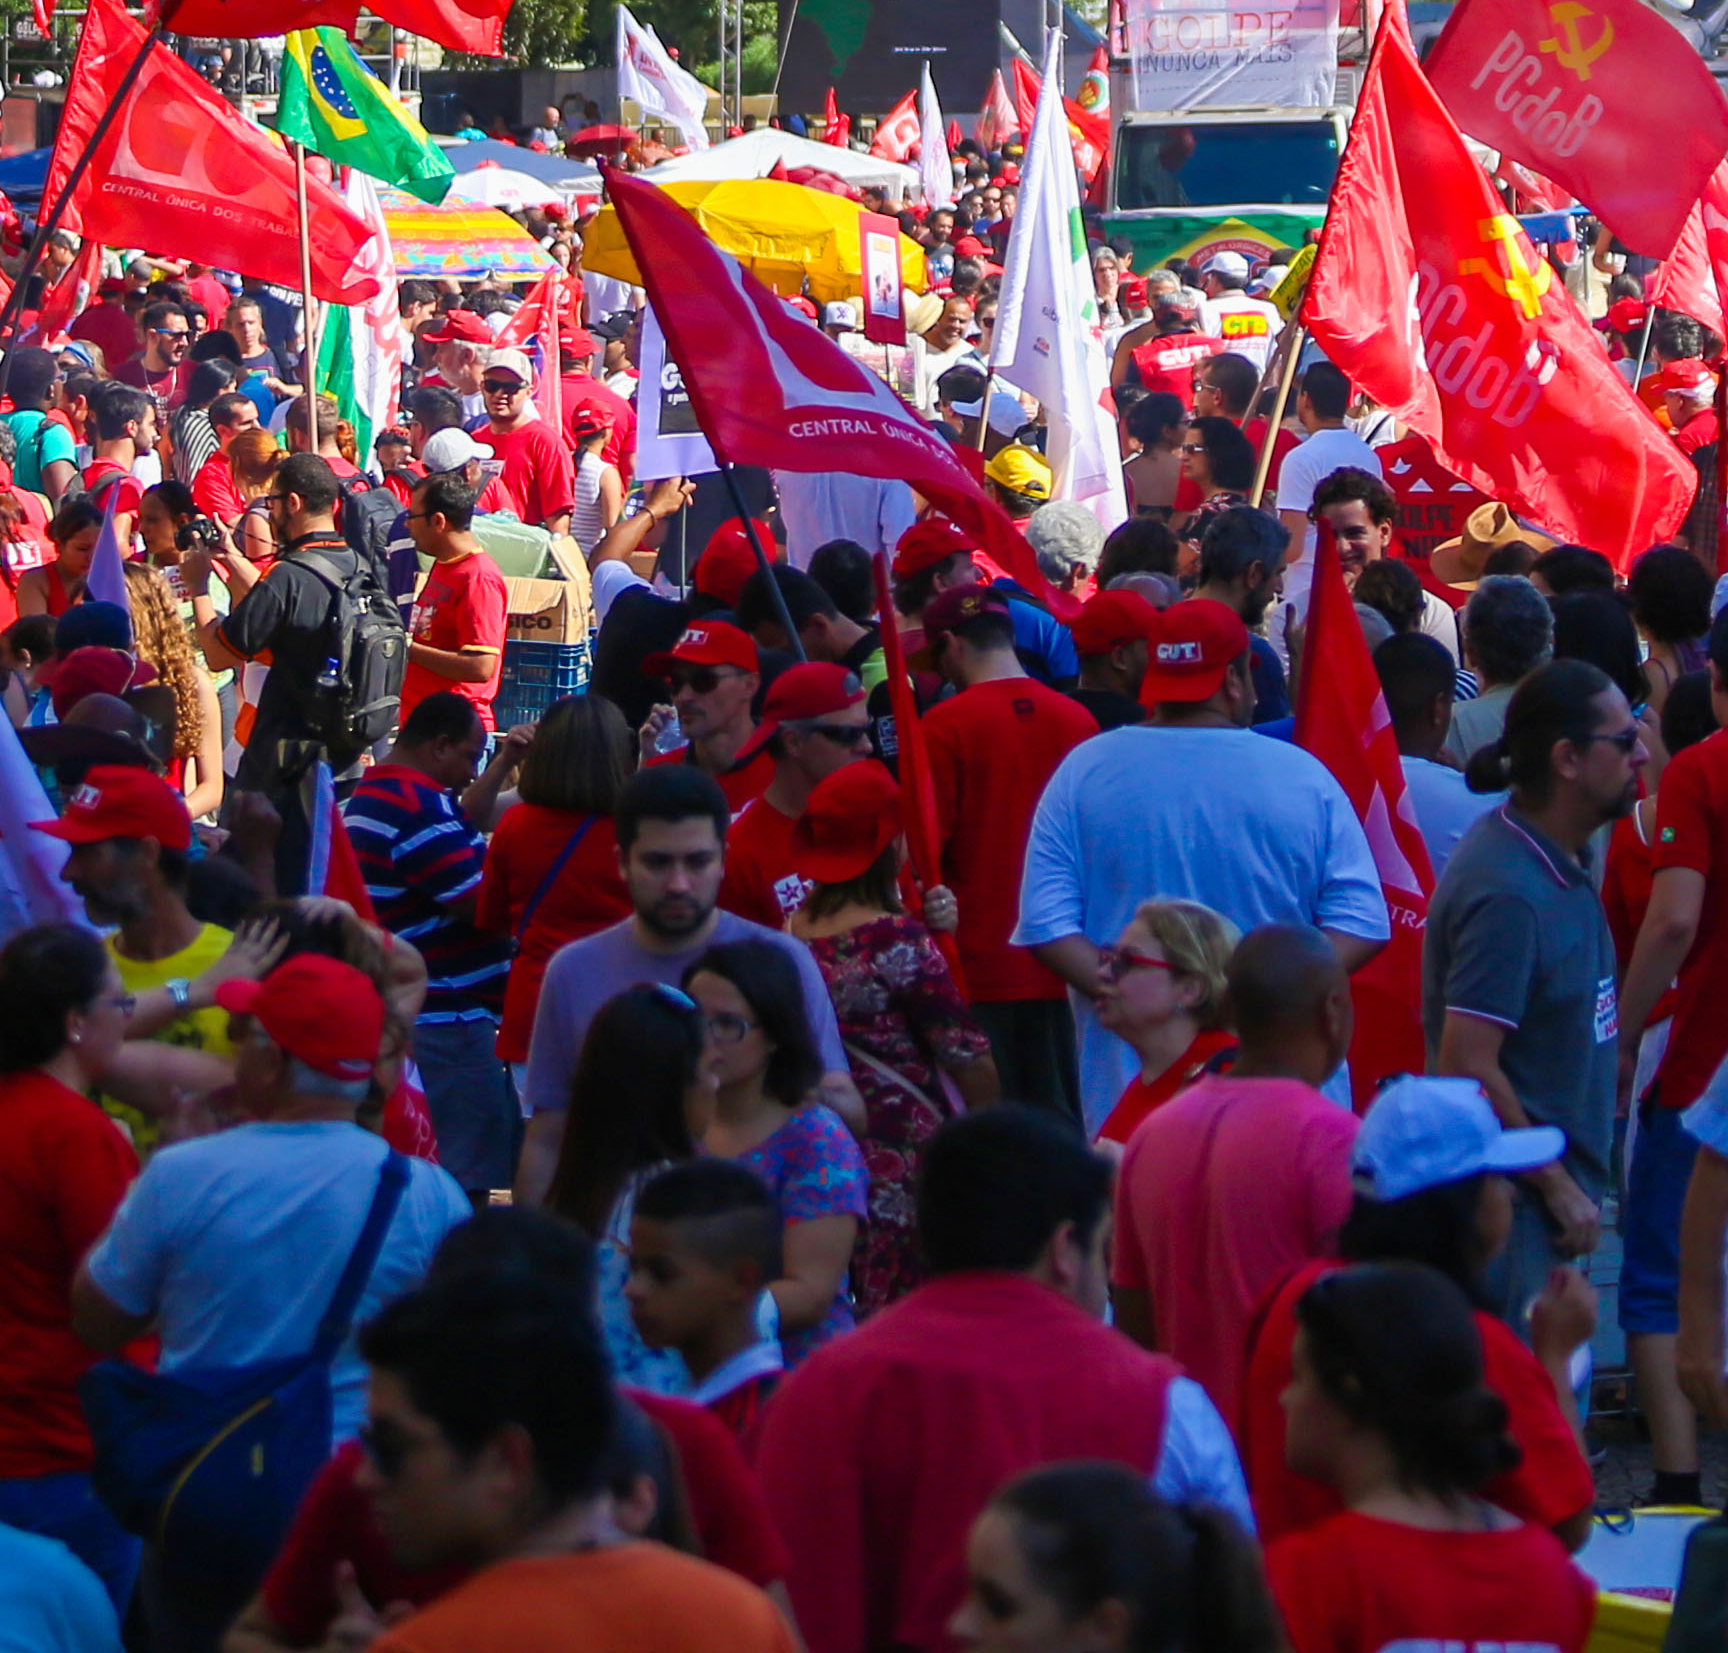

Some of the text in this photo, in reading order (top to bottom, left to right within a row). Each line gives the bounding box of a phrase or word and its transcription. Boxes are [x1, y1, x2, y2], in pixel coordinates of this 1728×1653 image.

[1146, 10, 1293, 52] GOLPE
[1144, 42, 1293, 74] NUNCA MAIS
[1470, 30, 1606, 159] PCdoB
[102, 181, 160, 203] CENTRAL
[166, 189, 208, 214] ÚNICA
[213, 203, 243, 218] DOS
[1223, 314, 1269, 335] CTB
[1158, 346, 1204, 366] CUT
[788, 416, 878, 439] CENTRAL
[1156, 642, 1196, 659] CUT
